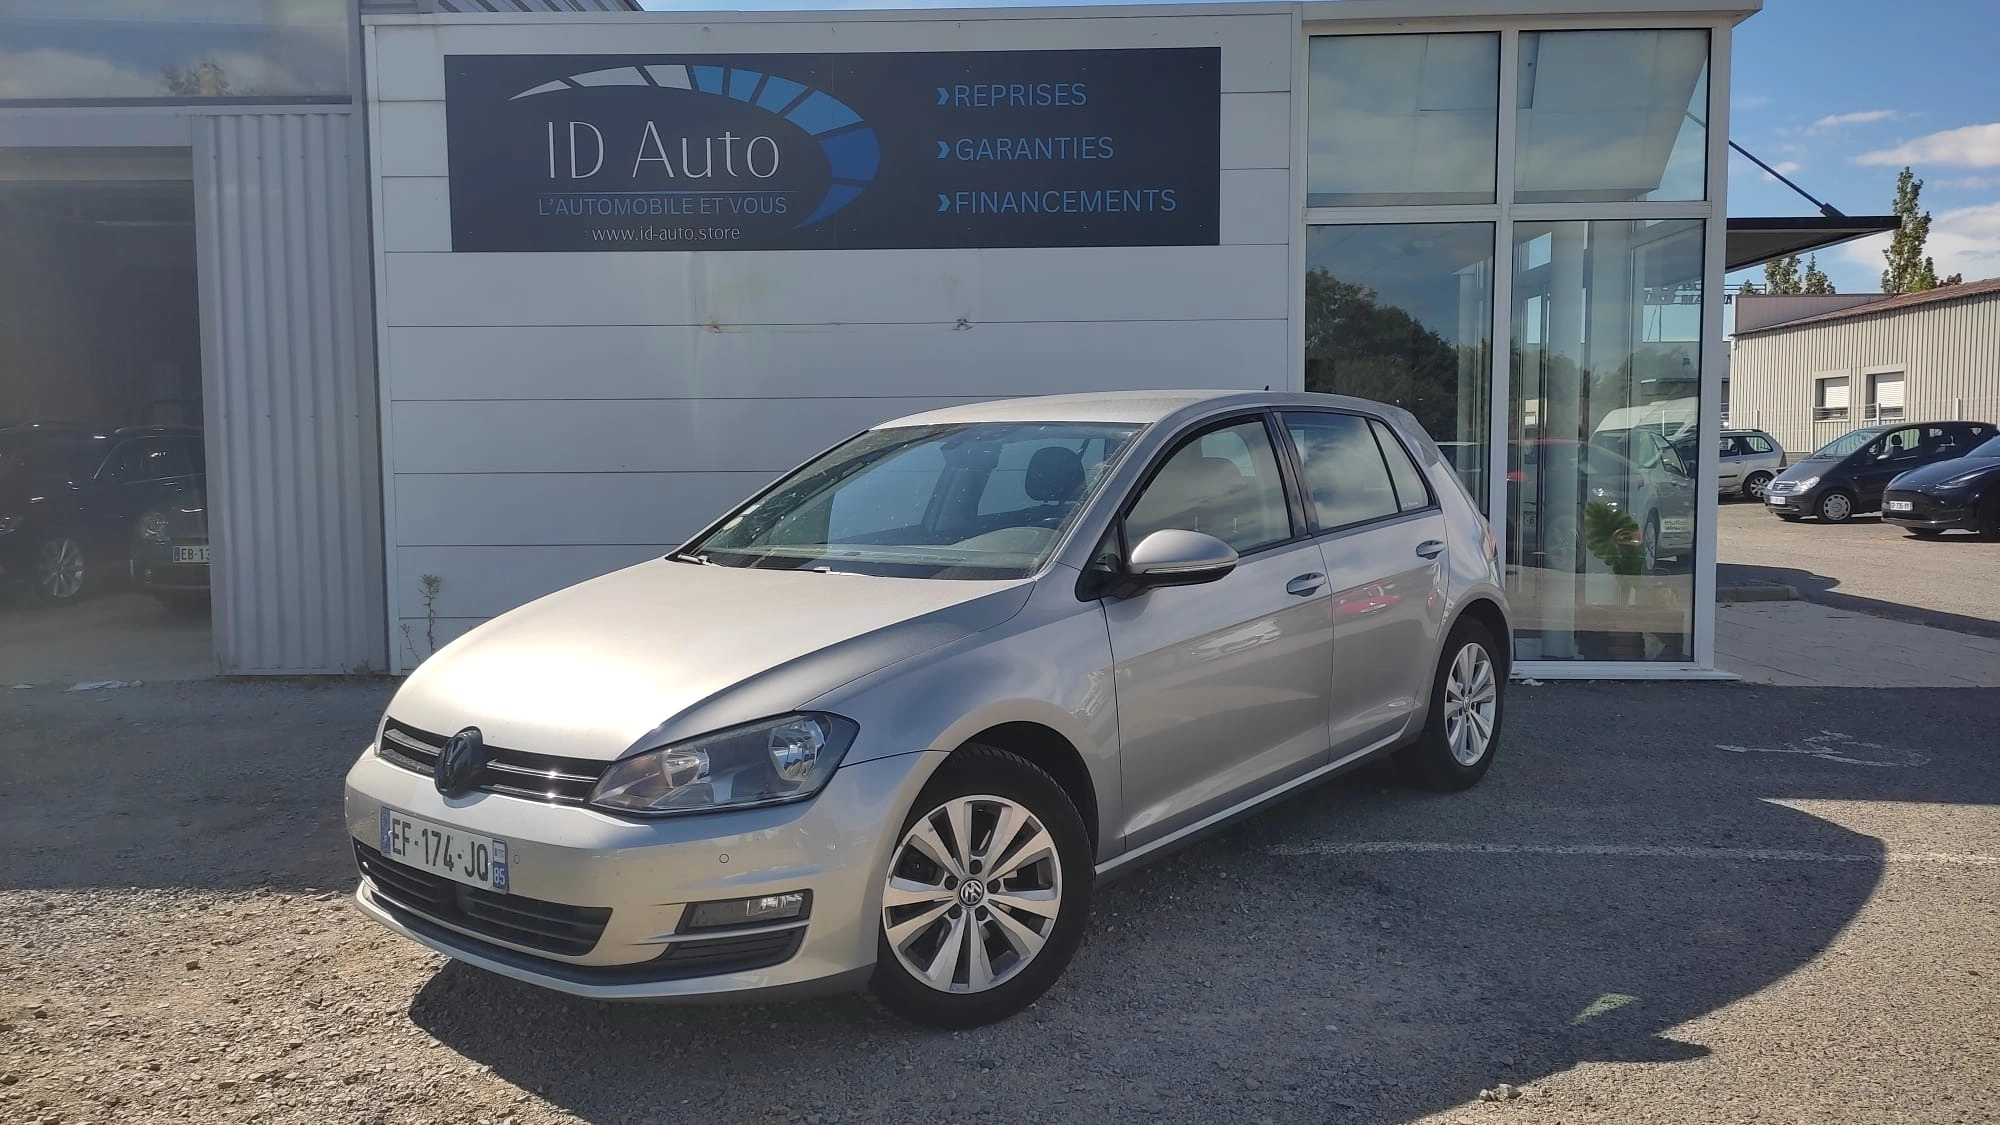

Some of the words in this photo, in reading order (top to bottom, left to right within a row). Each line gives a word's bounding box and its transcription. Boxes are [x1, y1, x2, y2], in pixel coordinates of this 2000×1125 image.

[954, 82, 1088, 108] REPRISES
[547, 120, 605, 179] ID
[631, 120, 780, 179] Auto
[954, 136, 1115, 161] GARANTIES
[537, 197, 695, 216] L'AUTOMOBILE
[700, 197, 721, 215] ET
[730, 196, 788, 215] VOUS
[955, 188, 1177, 214] FINANCEMENTS
[591, 224, 741, 242] www.id-auto.store
[391, 817, 489, 883] EF-174-JQ
[493, 866, 506, 886] 85
